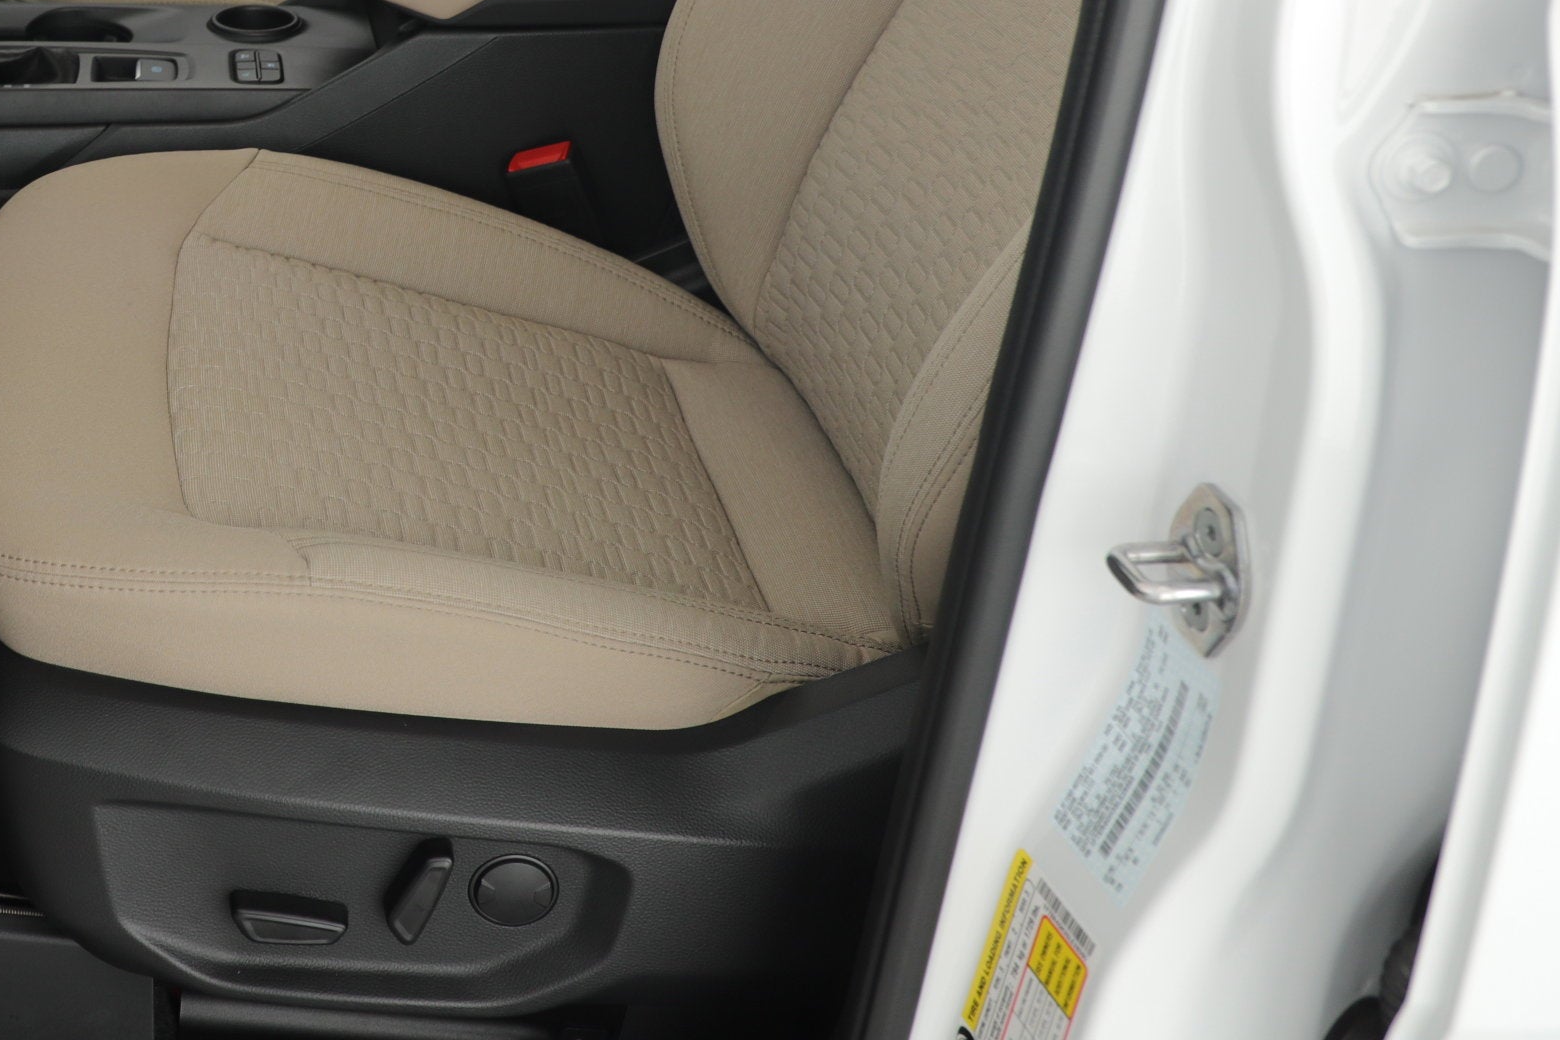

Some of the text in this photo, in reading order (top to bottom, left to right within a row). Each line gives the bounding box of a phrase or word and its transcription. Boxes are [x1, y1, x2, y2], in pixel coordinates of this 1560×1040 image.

[967, 998, 979, 1022] TIRE
[976, 976, 987, 999] AND
[985, 930, 1002, 975] LOADING
[1000, 858, 1028, 929] INFORMATION
